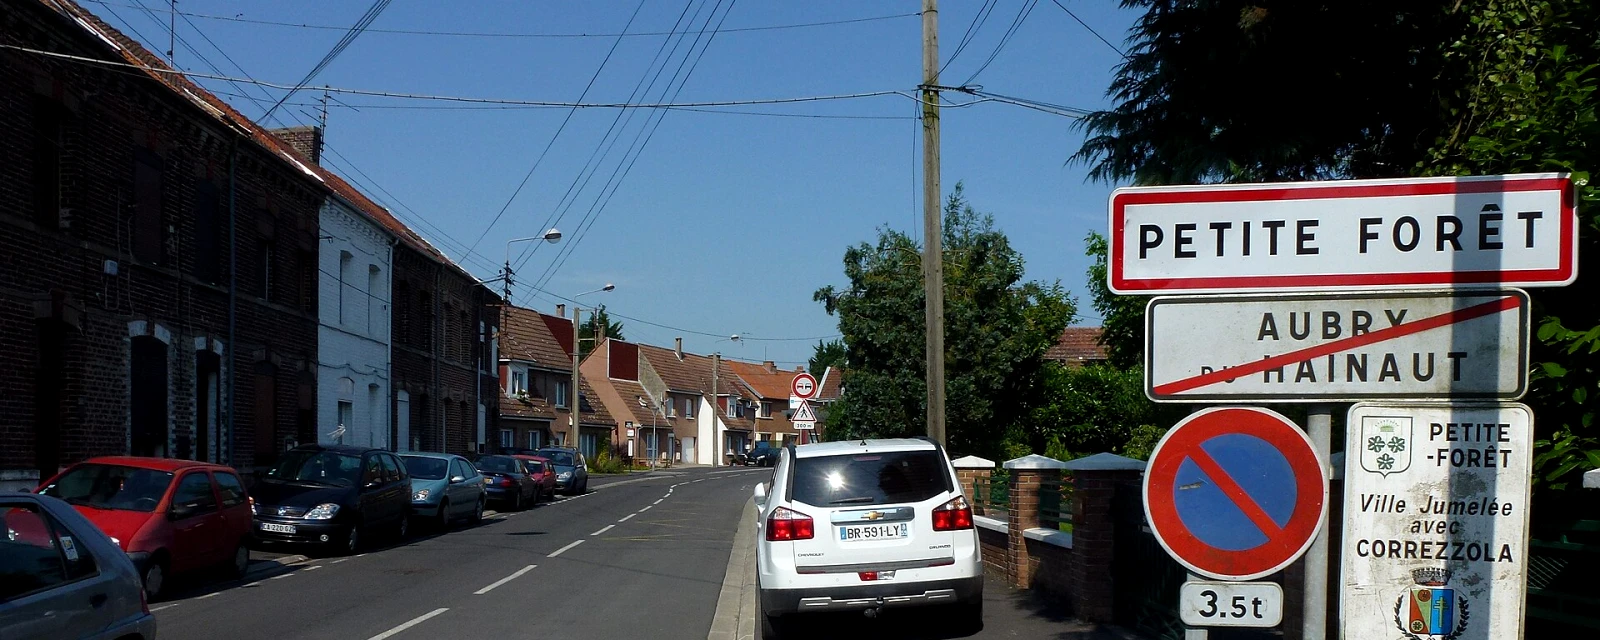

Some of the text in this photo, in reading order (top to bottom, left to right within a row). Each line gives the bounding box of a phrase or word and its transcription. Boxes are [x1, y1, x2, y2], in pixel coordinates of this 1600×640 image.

[1139, 203, 1543, 259] PETITE FORÊT
[1257, 309, 1408, 341] AUBRY
[1263, 352, 1467, 383] HAINAUT
[1429, 422, 1511, 442] PETITE
[1426, 446, 1512, 468] -FORÊT
[1360, 493, 1513, 516] Ville Jumelée
[1410, 519, 1460, 535] avec
[1356, 539, 1514, 563] CORREZZOLA
[1198, 589, 1264, 619] 3.5t
